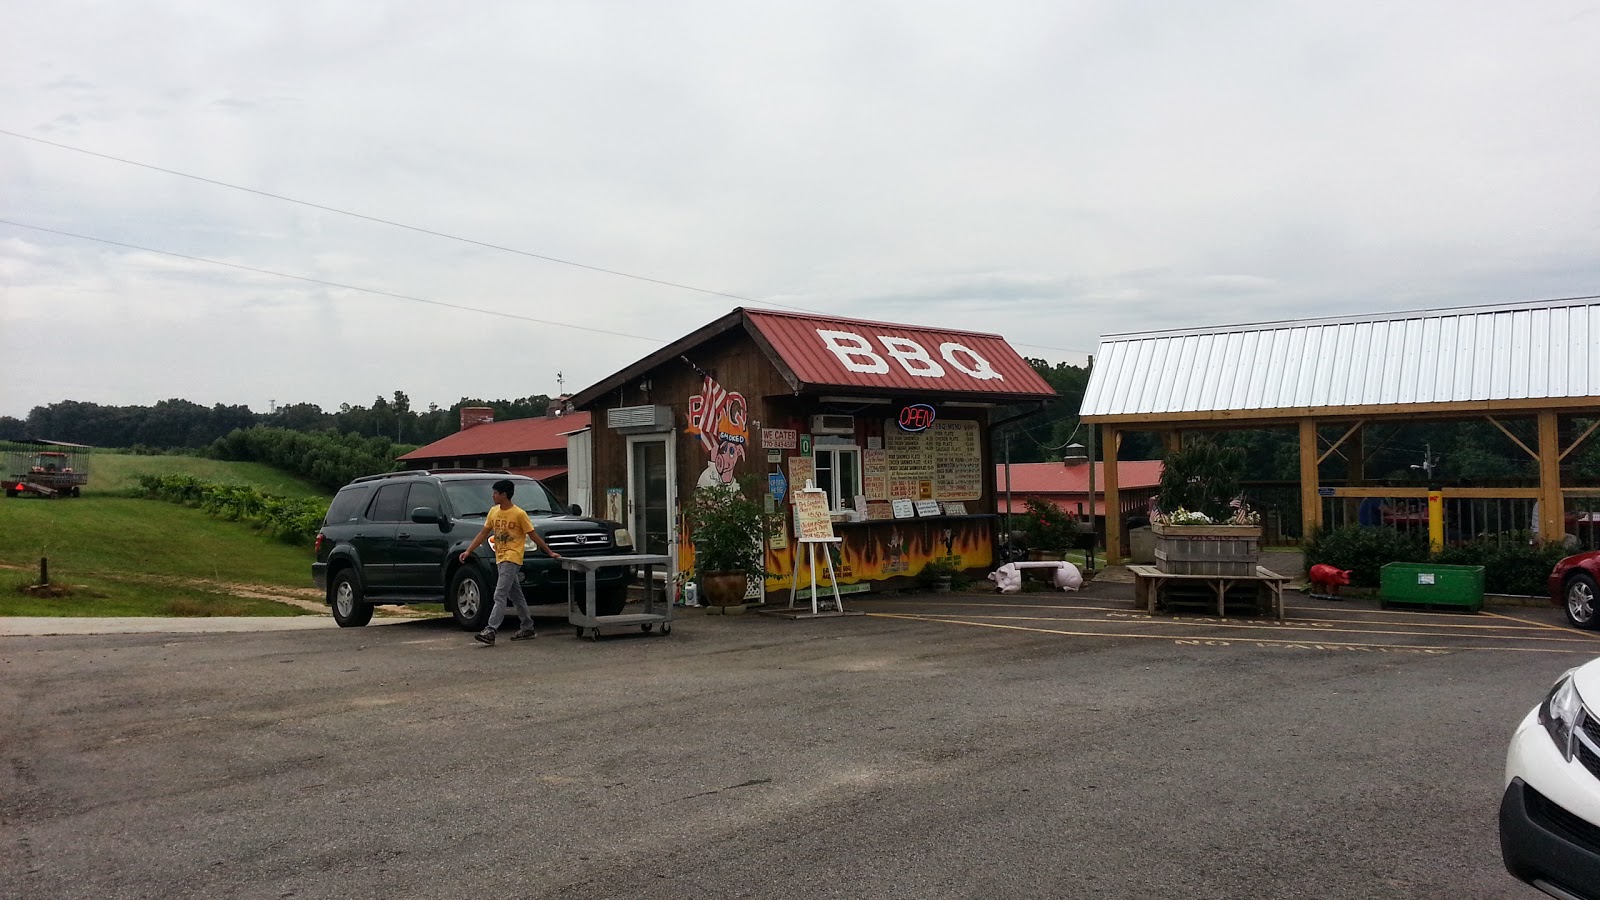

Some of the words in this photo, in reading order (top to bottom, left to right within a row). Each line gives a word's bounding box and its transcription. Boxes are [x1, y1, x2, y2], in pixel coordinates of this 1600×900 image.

[816, 328, 1004, 382] BBQ
[689, 392, 747, 431] BQ
[900, 407, 933, 427] OPEN
[720, 432, 744, 443] SMOKED
[764, 430, 772, 439] WE
[775, 430, 796, 440] CATER
[1175, 639, 1230, 647] NO
